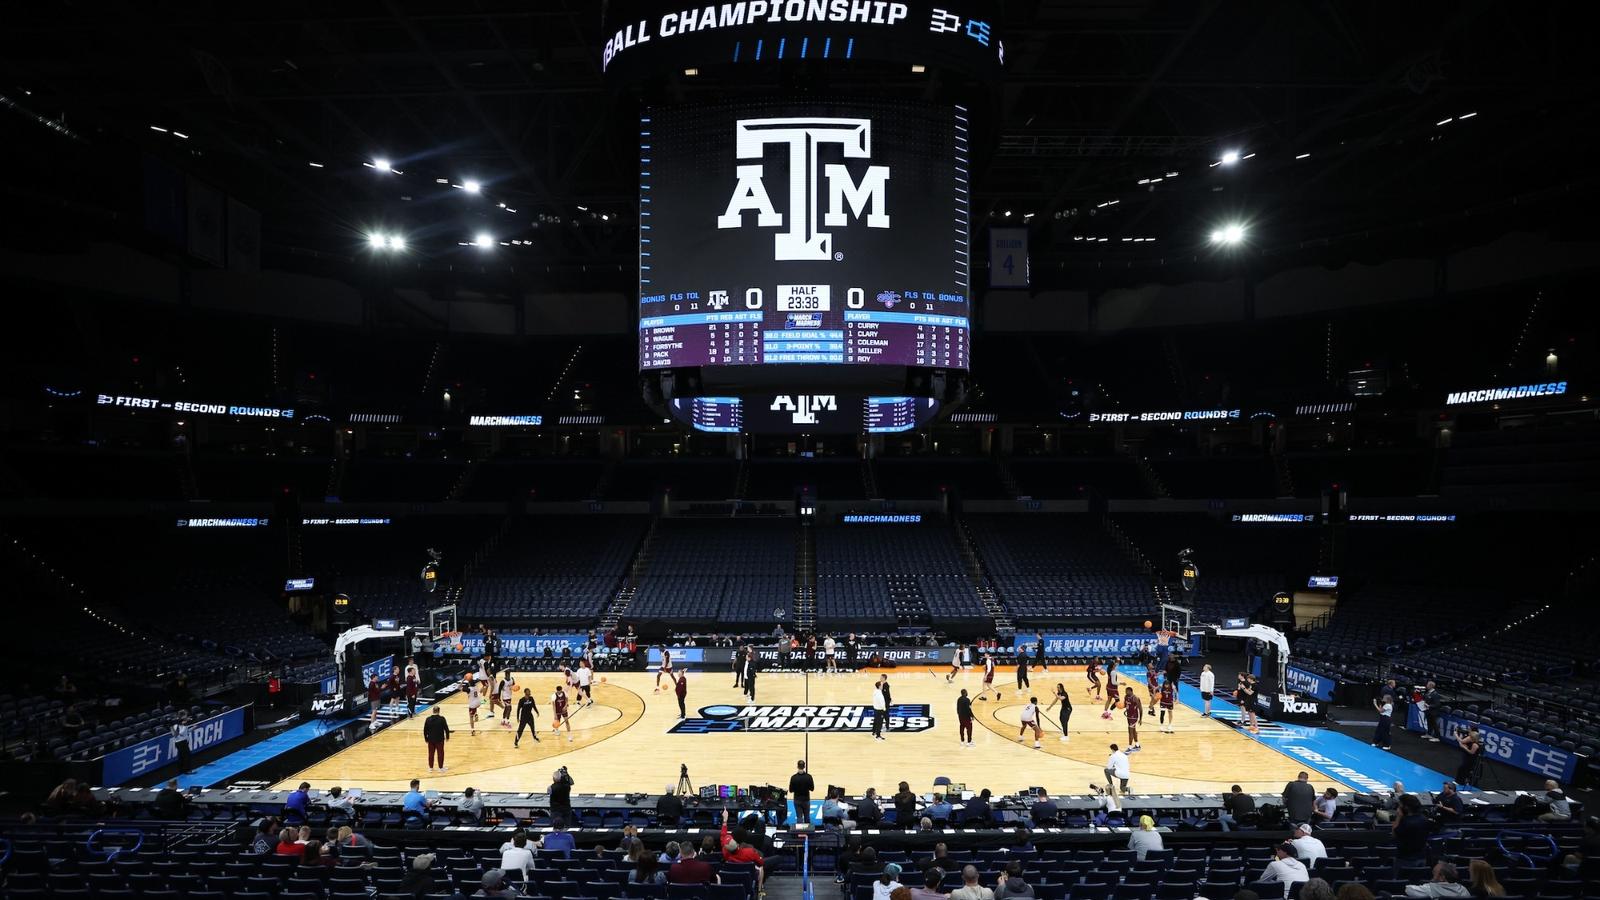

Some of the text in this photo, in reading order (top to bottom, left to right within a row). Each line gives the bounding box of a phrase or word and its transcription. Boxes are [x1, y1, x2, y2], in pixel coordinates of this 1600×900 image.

[603, 0, 908, 72] BALL CHAMPIONSHIP
[1003, 255, 1014, 275] 4
[642, 295, 665, 303] BONUS
[746, 288, 762, 309] 0
[788, 297, 819, 308] 23:38
[847, 288, 864, 308] 0
[939, 294, 963, 302] BONUS
[1446, 382, 1567, 404] MARCHMADNESS
[116, 397, 159, 408] FIRST
[174, 402, 226, 414] SECOND
[229, 406, 280, 418] ROUNDS
[470, 416, 542, 425] MARCHMADNESS
[1101, 414, 1129, 422] FIRST
[1141, 412, 1181, 421] SECOND
[1184, 410, 1228, 419] ROUNDS
[1061, 639, 1084, 647] ROAD
[1085, 639, 1118, 649] FINAL
[738, 706, 865, 717] MARCH
[1283, 702, 1318, 713] NCAA
[750, 717, 929, 728] MADNESS
[1281, 745, 1343, 766] FIRST
